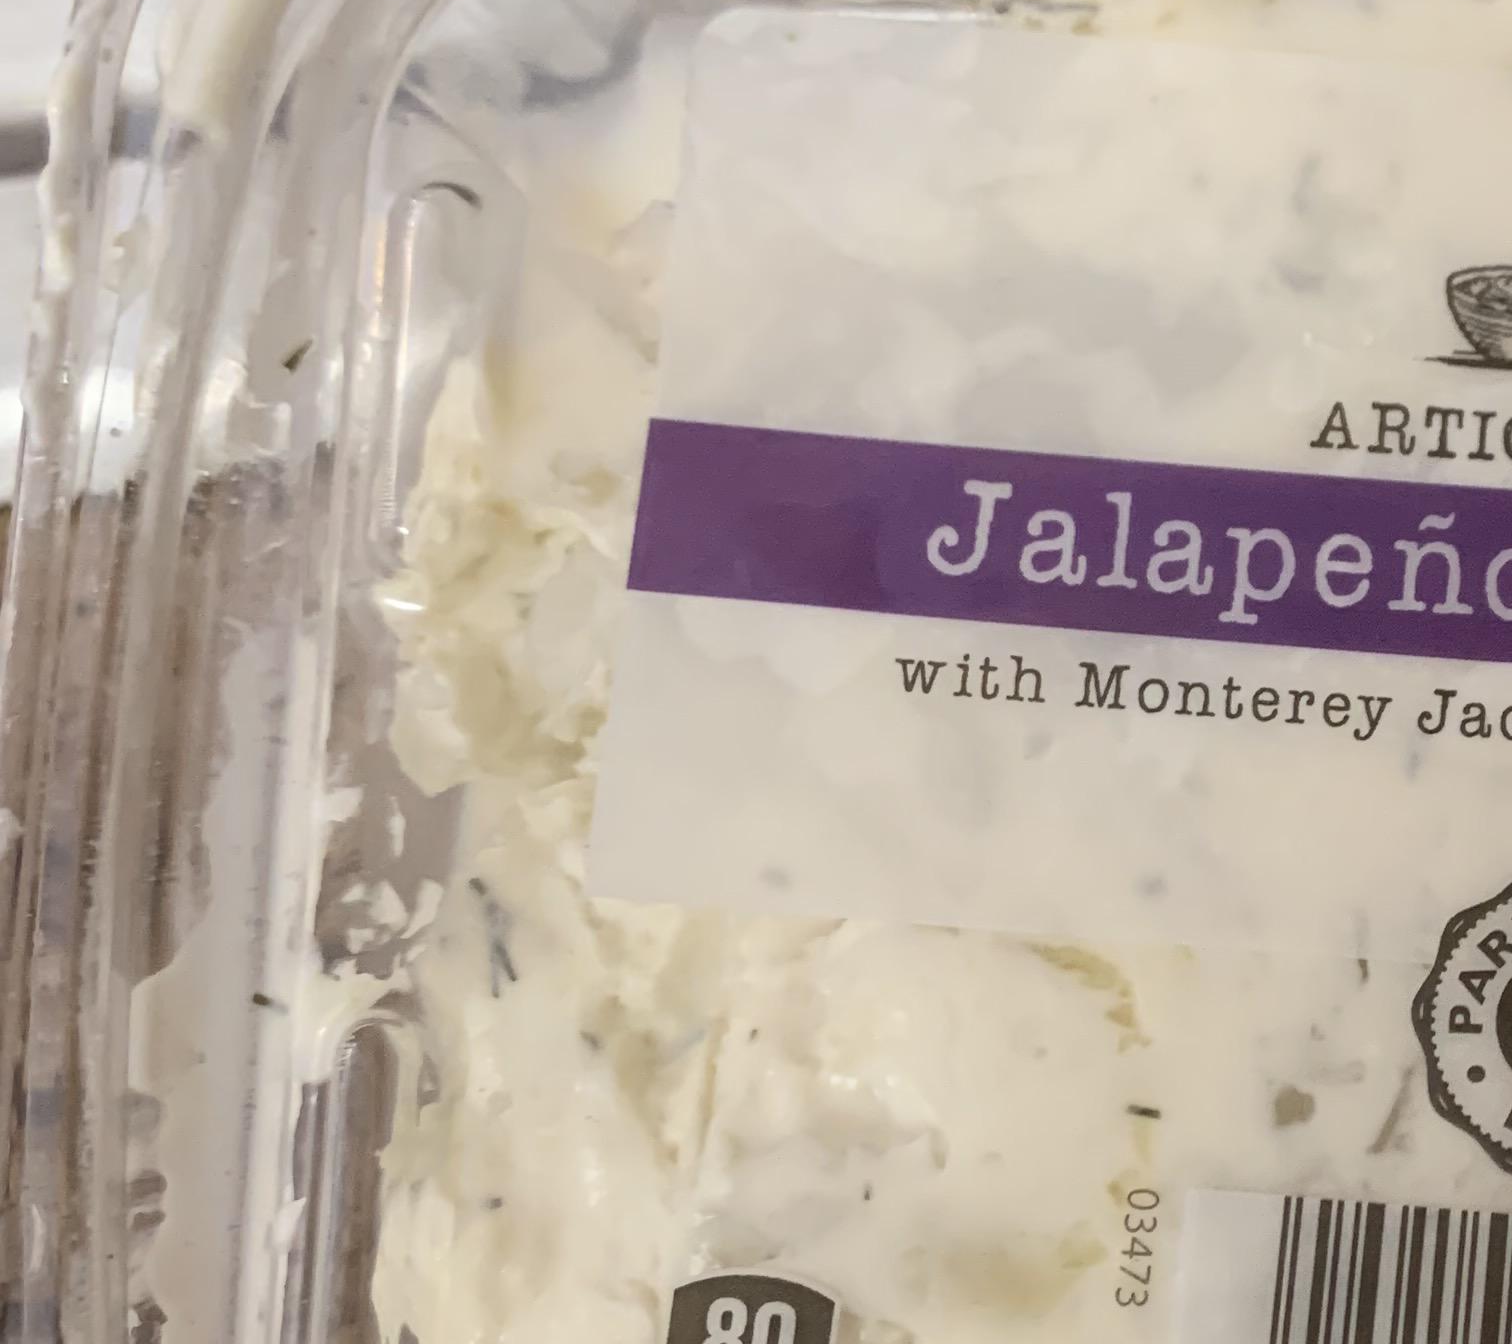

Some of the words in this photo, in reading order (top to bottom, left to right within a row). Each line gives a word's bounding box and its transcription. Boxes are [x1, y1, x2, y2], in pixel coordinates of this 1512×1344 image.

[895, 655, 1047, 704] with
[1074, 662, 1393, 742] Monterey
[1115, 1187, 1161, 1309] 03473
